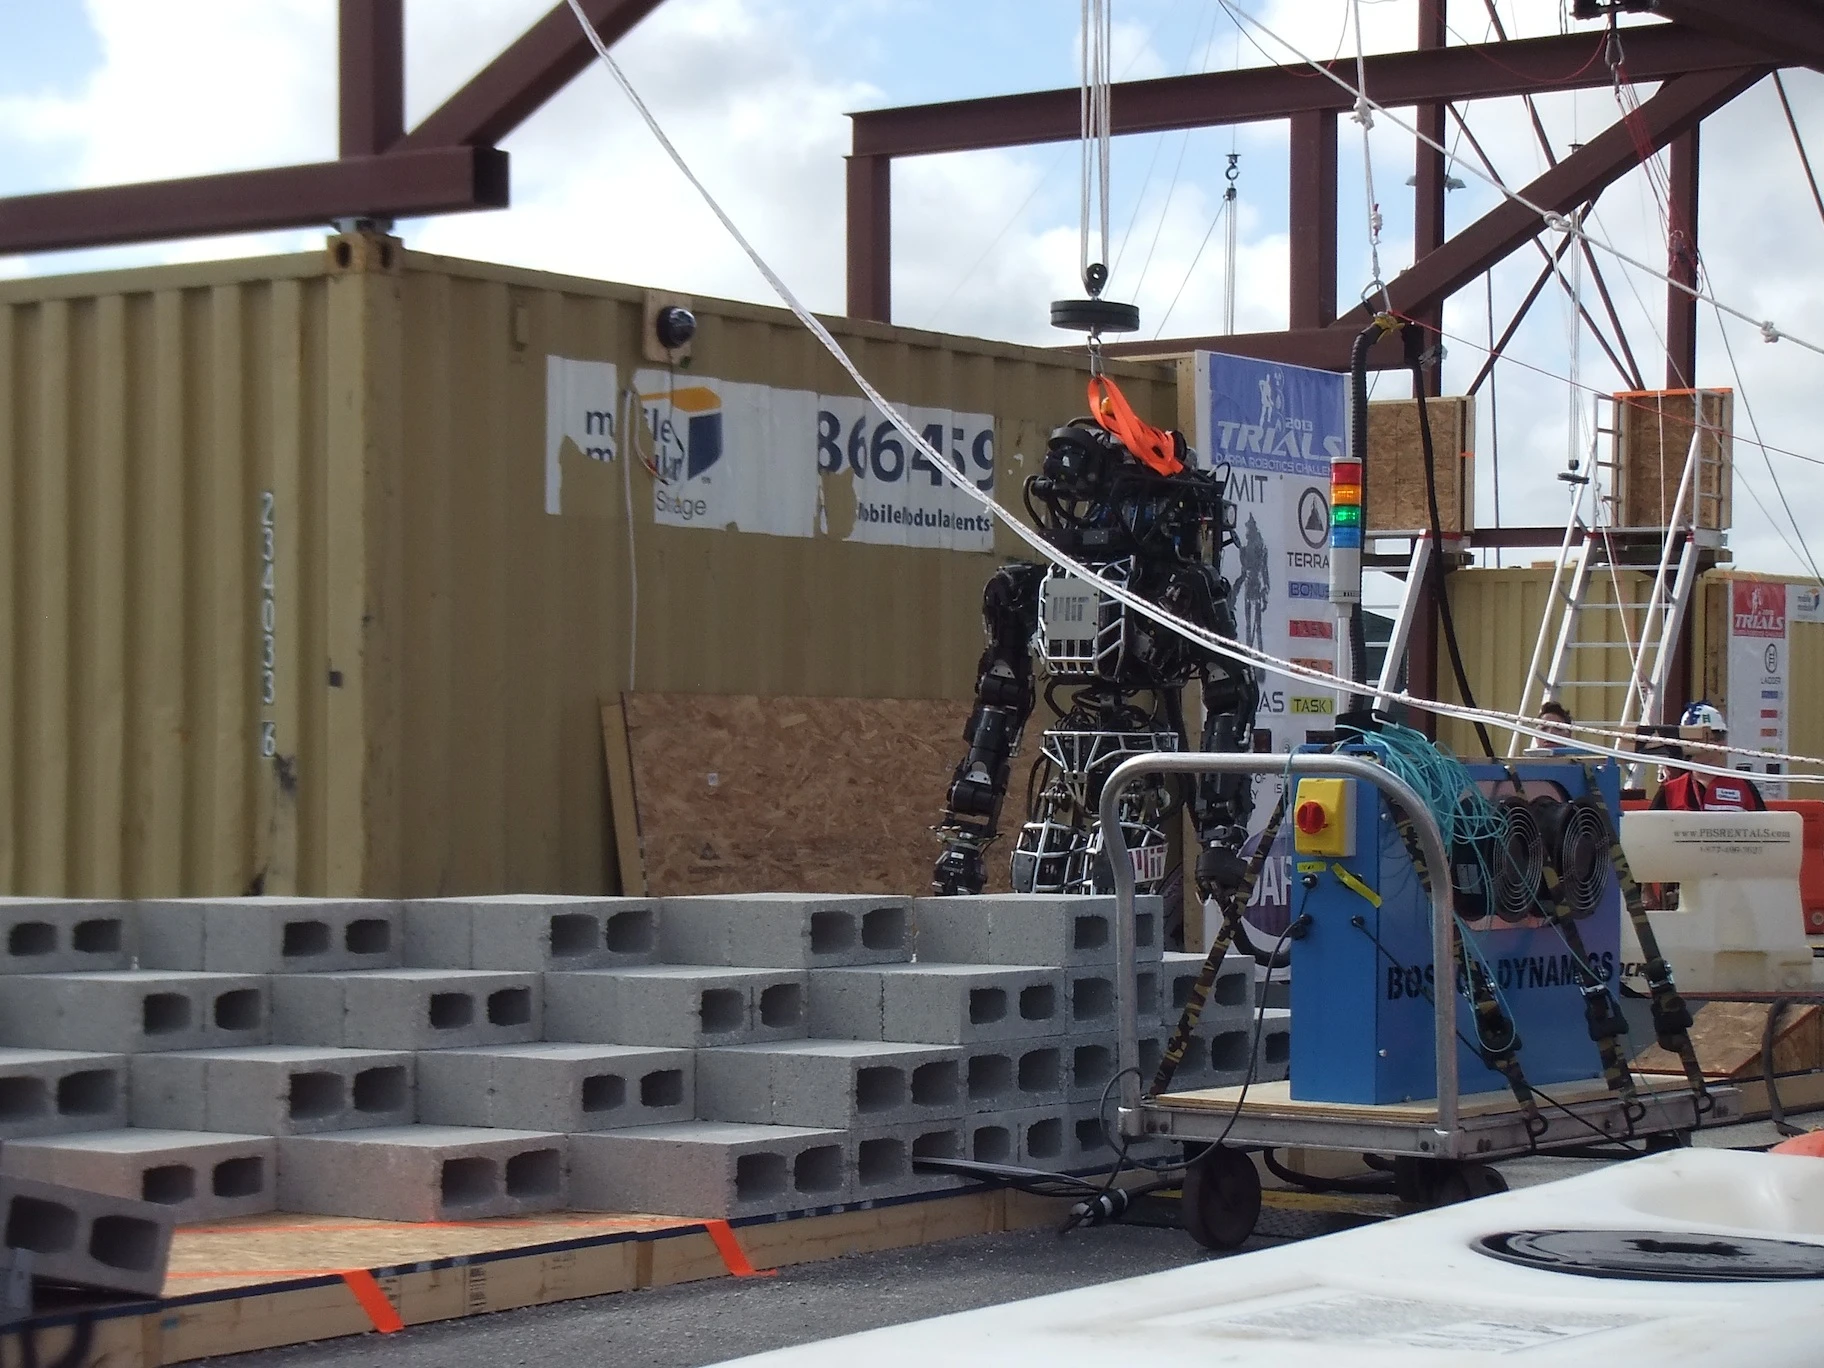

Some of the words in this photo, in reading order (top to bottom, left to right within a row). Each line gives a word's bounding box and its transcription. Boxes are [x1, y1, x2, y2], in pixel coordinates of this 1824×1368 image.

[1217, 420, 1342, 461] TRIALS
[1249, 456, 1295, 474] ROBOTICS
[1229, 473, 1268, 503] MIT
[1287, 551, 1330, 569] TERRA
[1735, 613, 1784, 630] TRIALS
[1293, 698, 1327, 713] TASK
[1497, 951, 1614, 989] DYNAMCS
